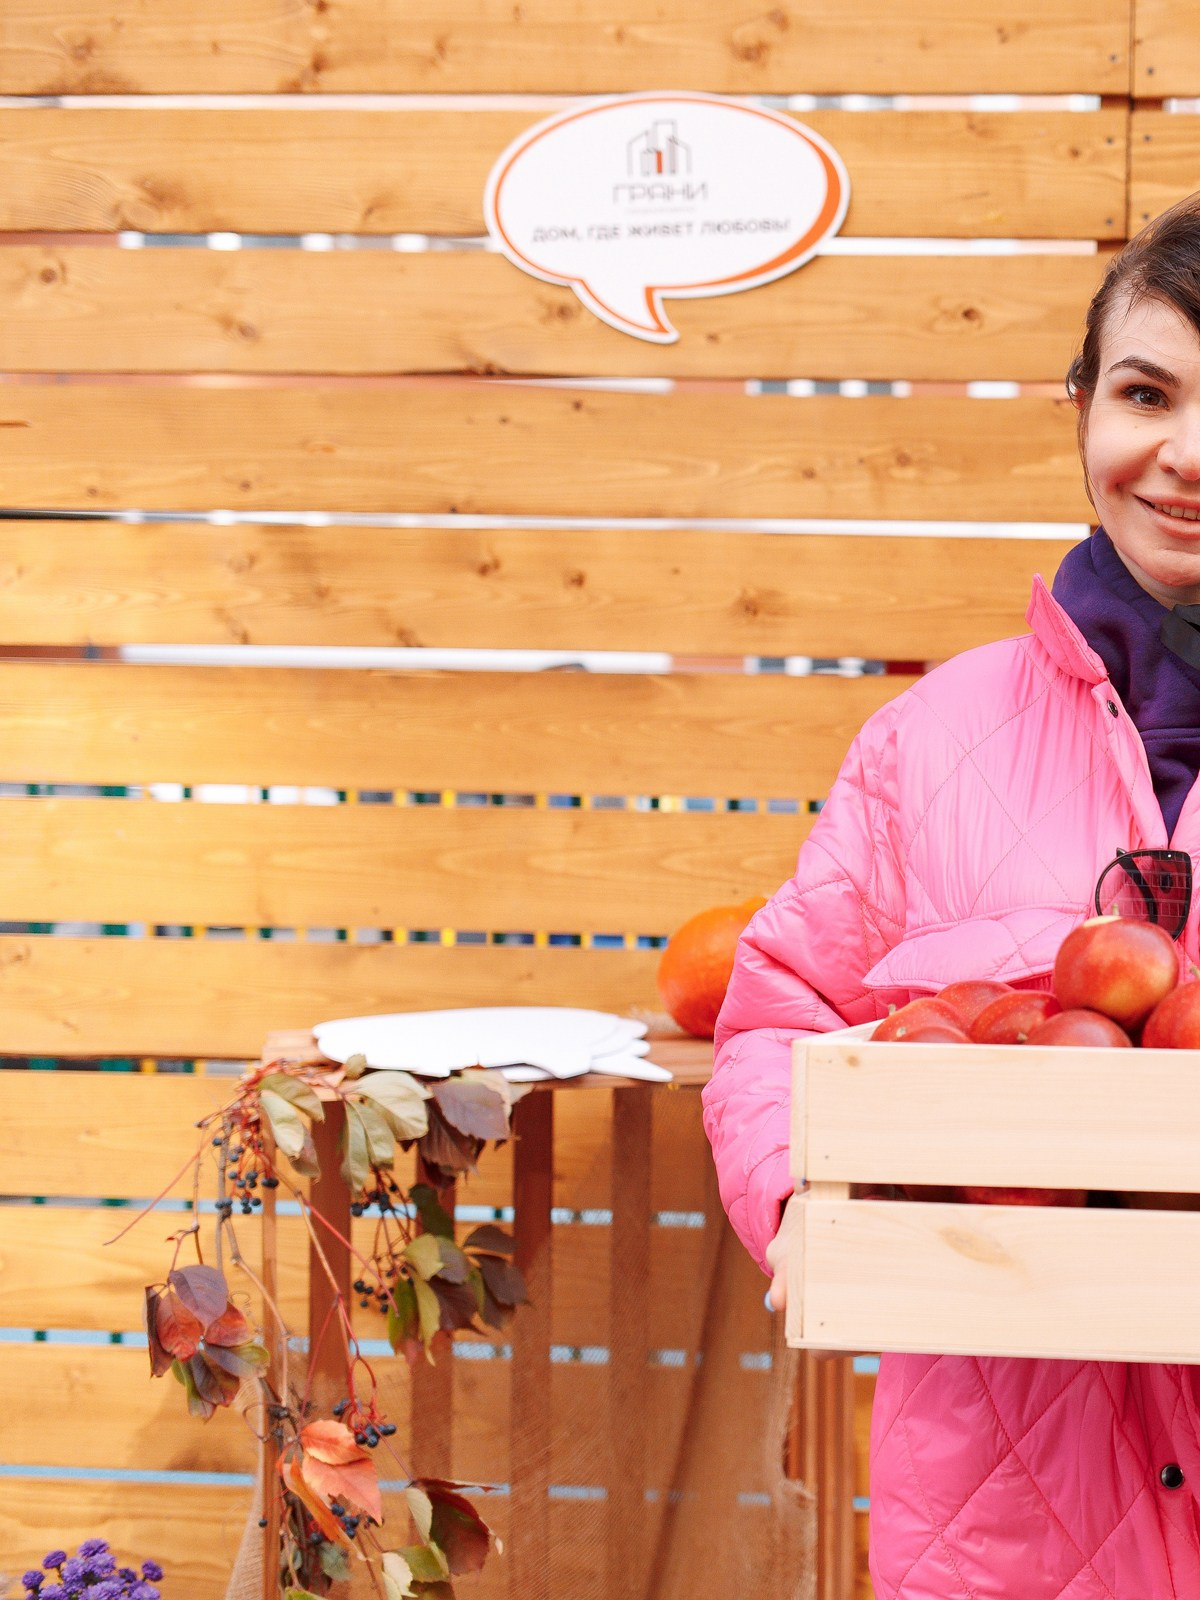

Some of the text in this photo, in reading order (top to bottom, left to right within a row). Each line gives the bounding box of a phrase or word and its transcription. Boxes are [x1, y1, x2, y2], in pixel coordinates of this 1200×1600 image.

[613, 181, 709, 204] ГРАНИ
[531, 224, 581, 243] ДОМ,
[586, 223, 621, 241] ГДЕ
[627, 220, 694, 238] ЖИВЕТ
